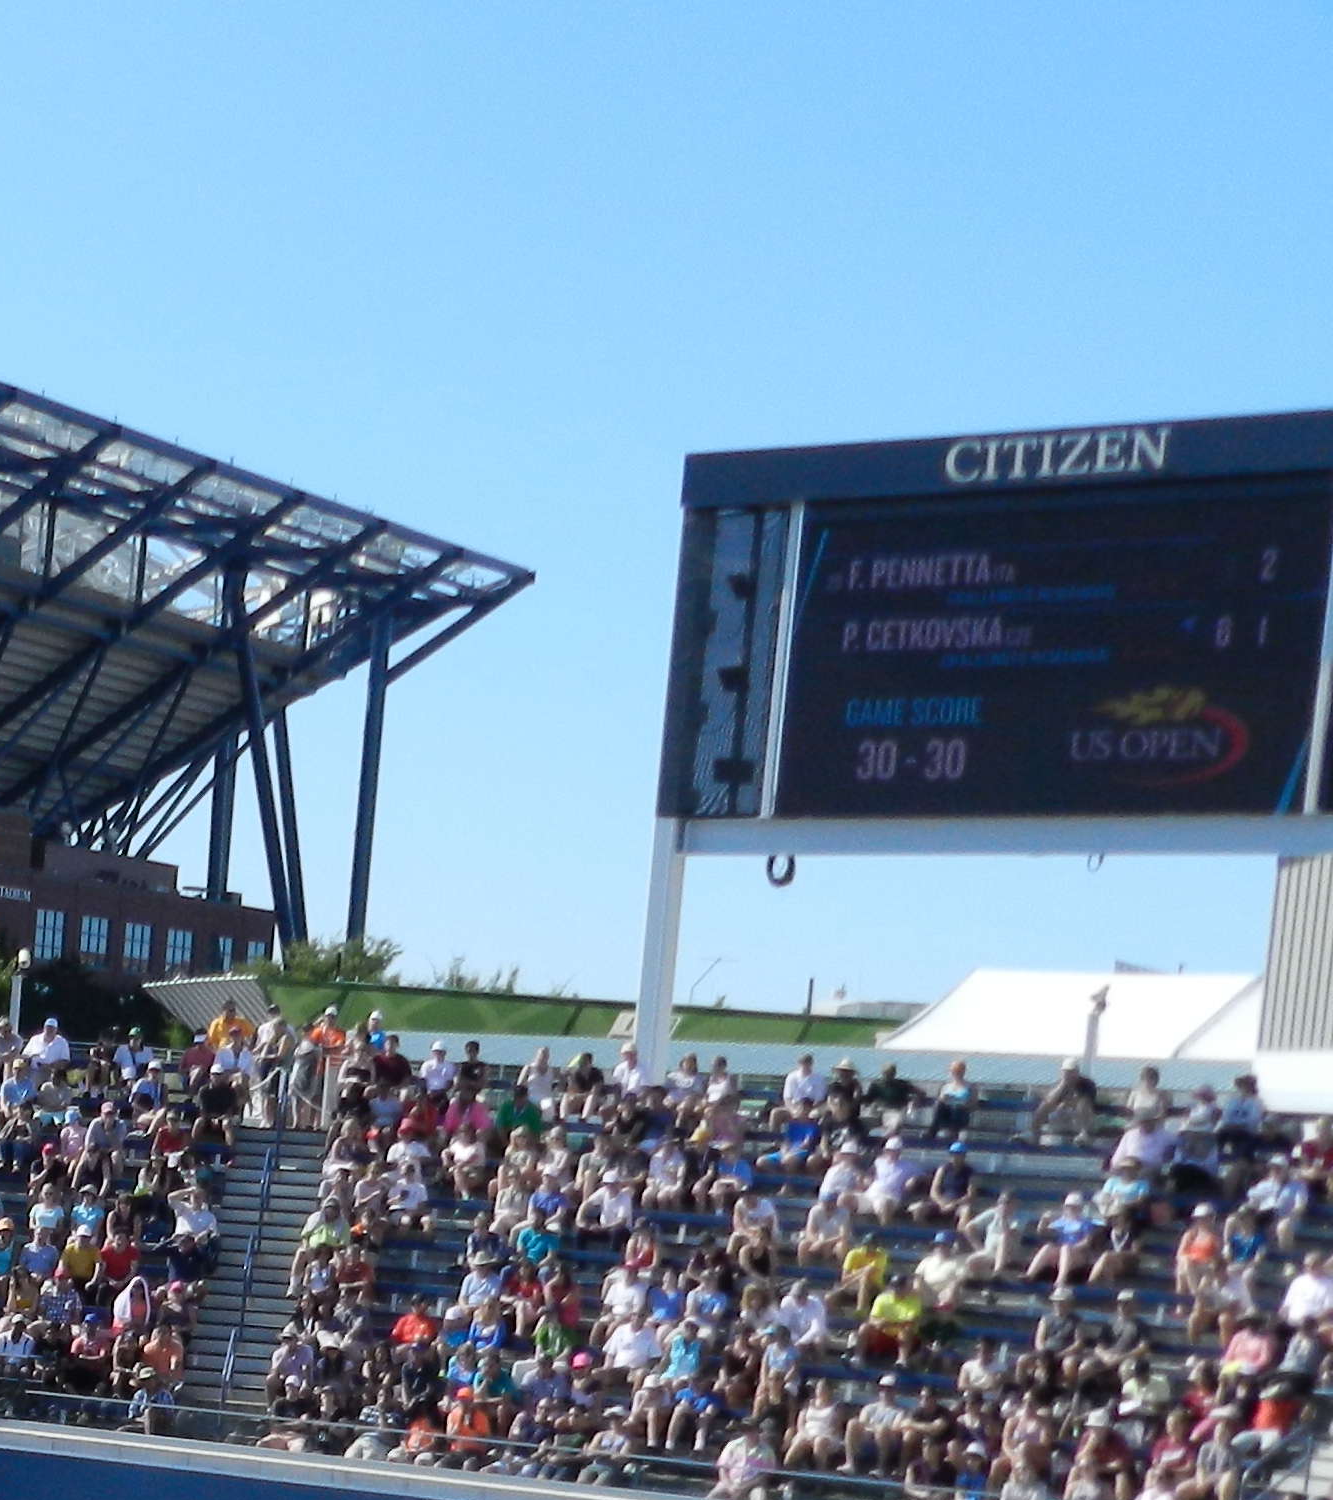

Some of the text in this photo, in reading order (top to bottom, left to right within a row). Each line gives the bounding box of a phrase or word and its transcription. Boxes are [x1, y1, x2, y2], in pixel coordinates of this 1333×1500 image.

[944, 427, 1171, 483] CITIZEN
[870, 554, 990, 589] PENNETTA
[1260, 547, 1278, 581] 2
[865, 615, 1002, 651] CETKOVSKA
[845, 696, 982, 727] GAME SCORE
[856, 740, 897, 780] 30
[924, 739, 966, 779] 30
[1070, 729, 1221, 760] US OPEN
